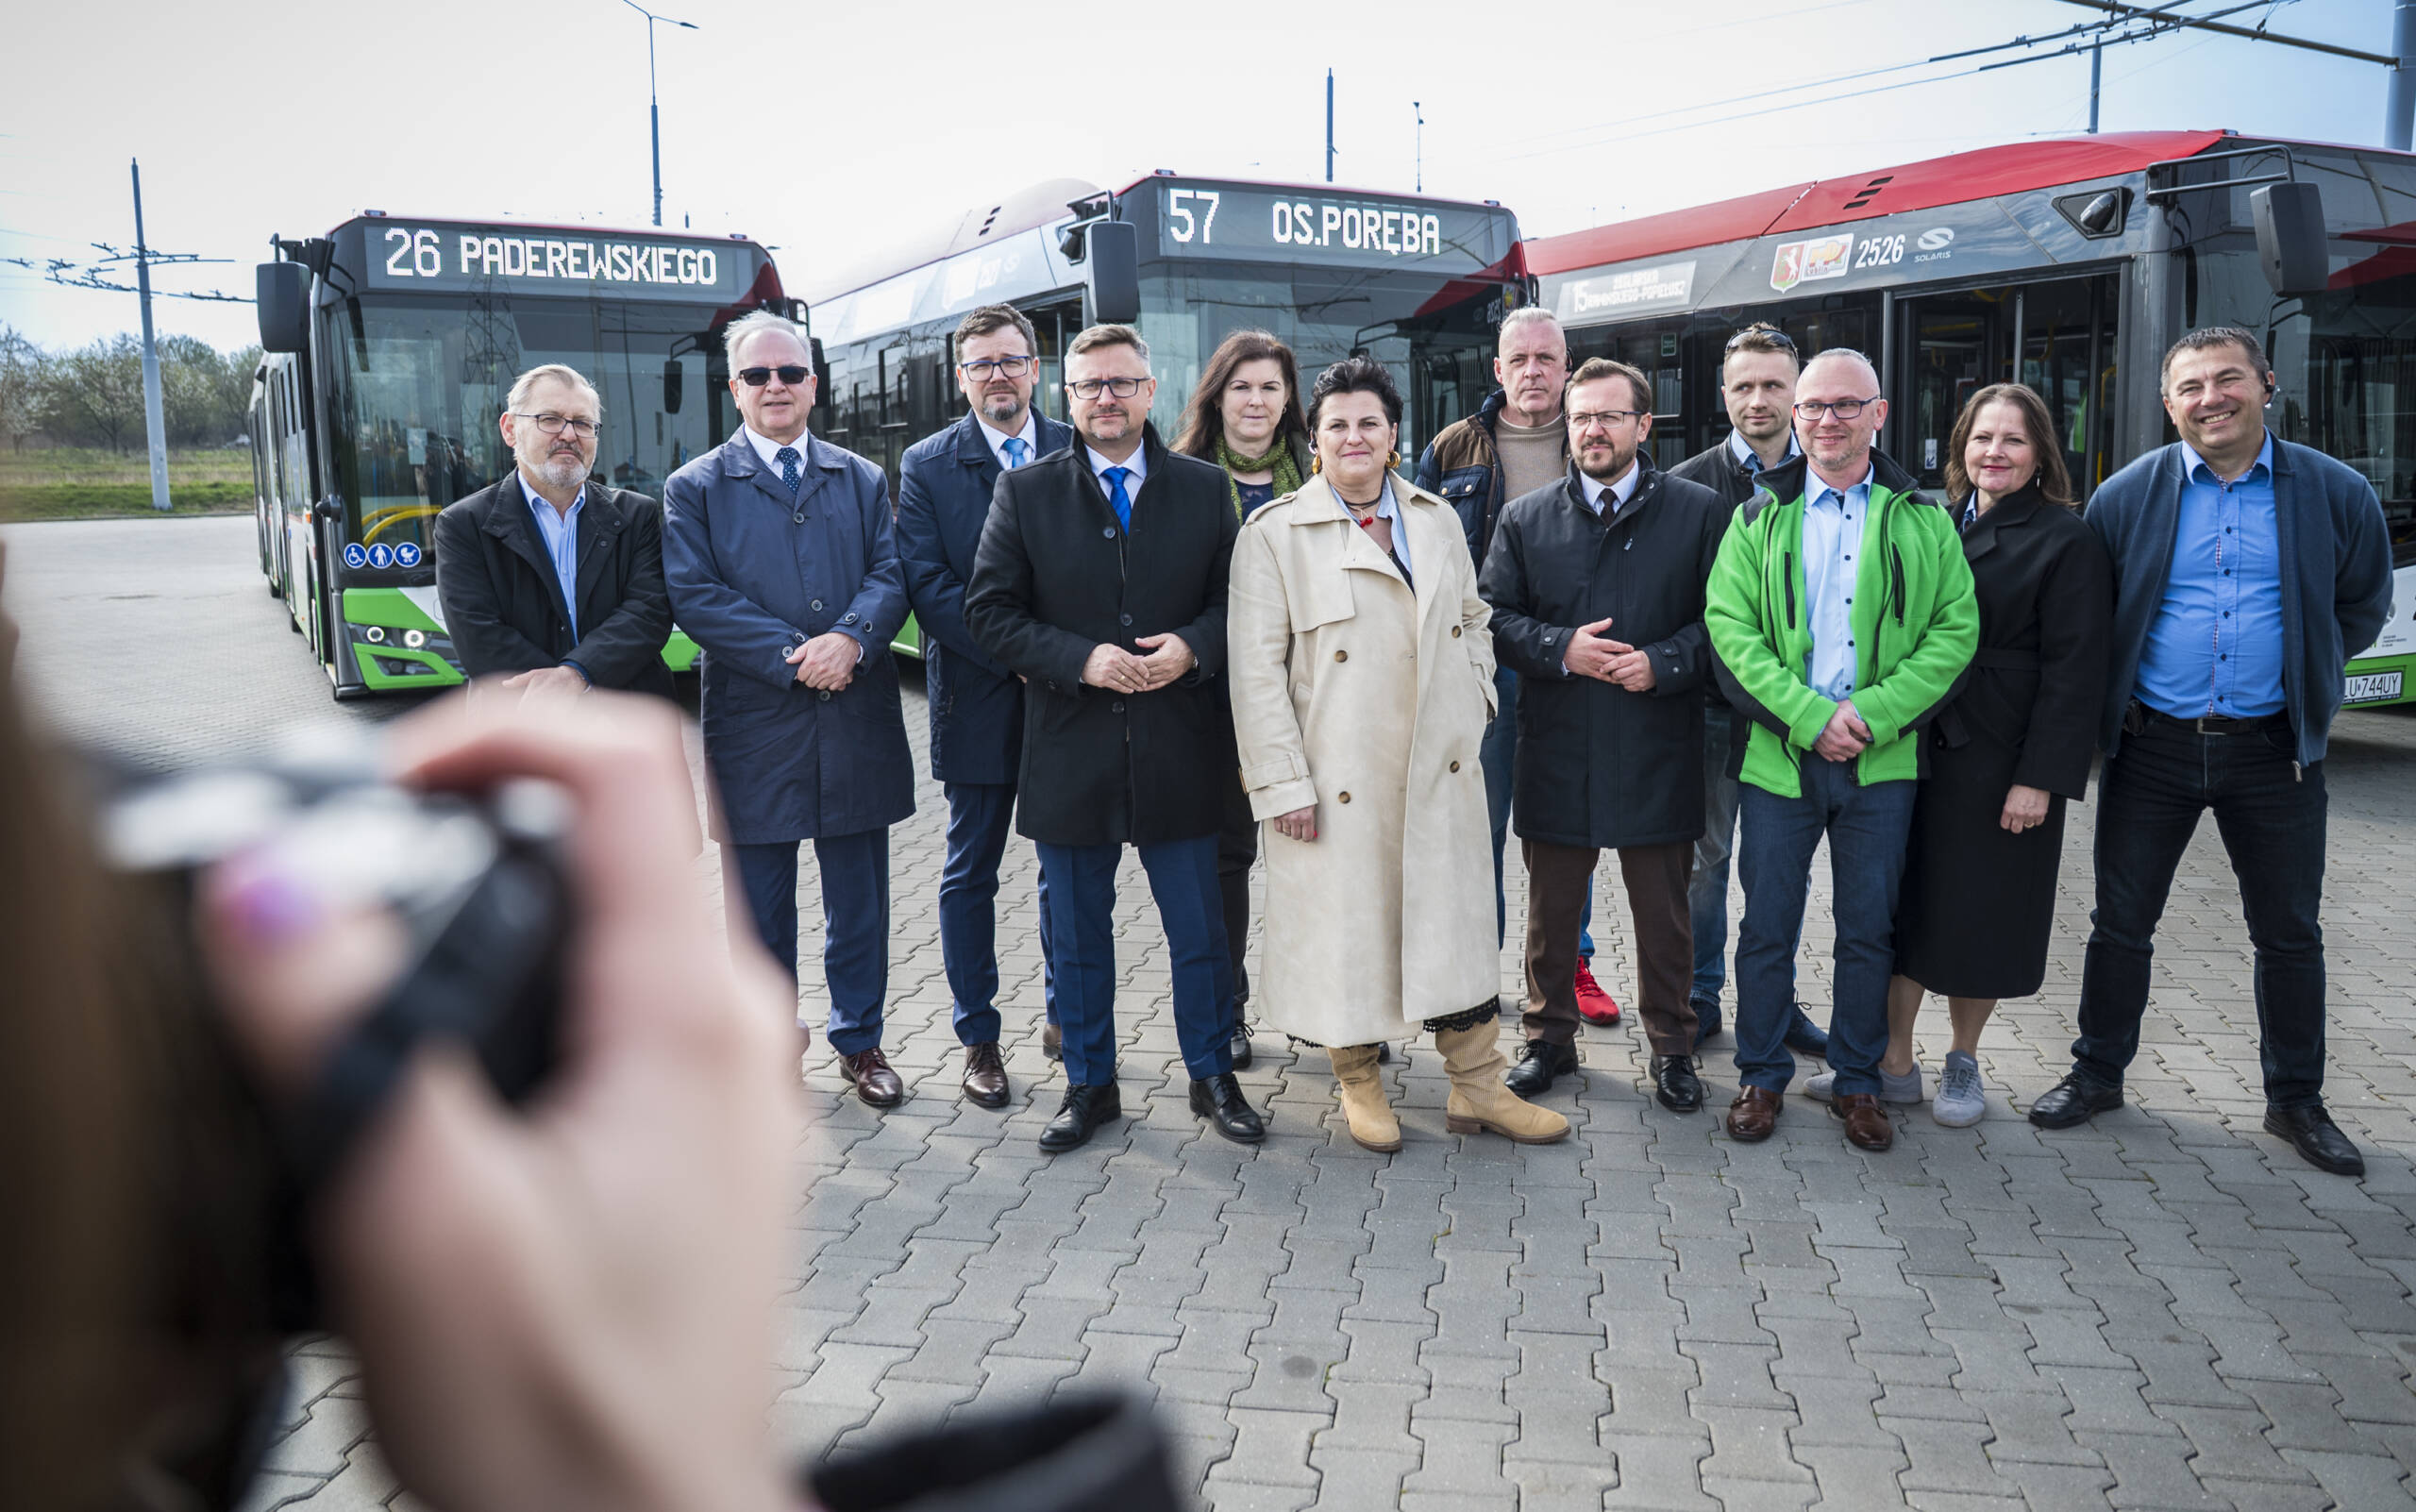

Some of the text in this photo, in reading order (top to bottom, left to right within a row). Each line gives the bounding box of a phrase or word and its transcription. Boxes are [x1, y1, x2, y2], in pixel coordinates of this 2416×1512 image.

[1169, 189, 1440, 255] 57 OS.PORĘBA
[385, 227, 717, 285] 26 PADEREWSKIEGO
[1854, 234, 1905, 269] 2526
[1914, 250, 1952, 263] SOLARIS
[2344, 675, 2398, 697] U 744UY
